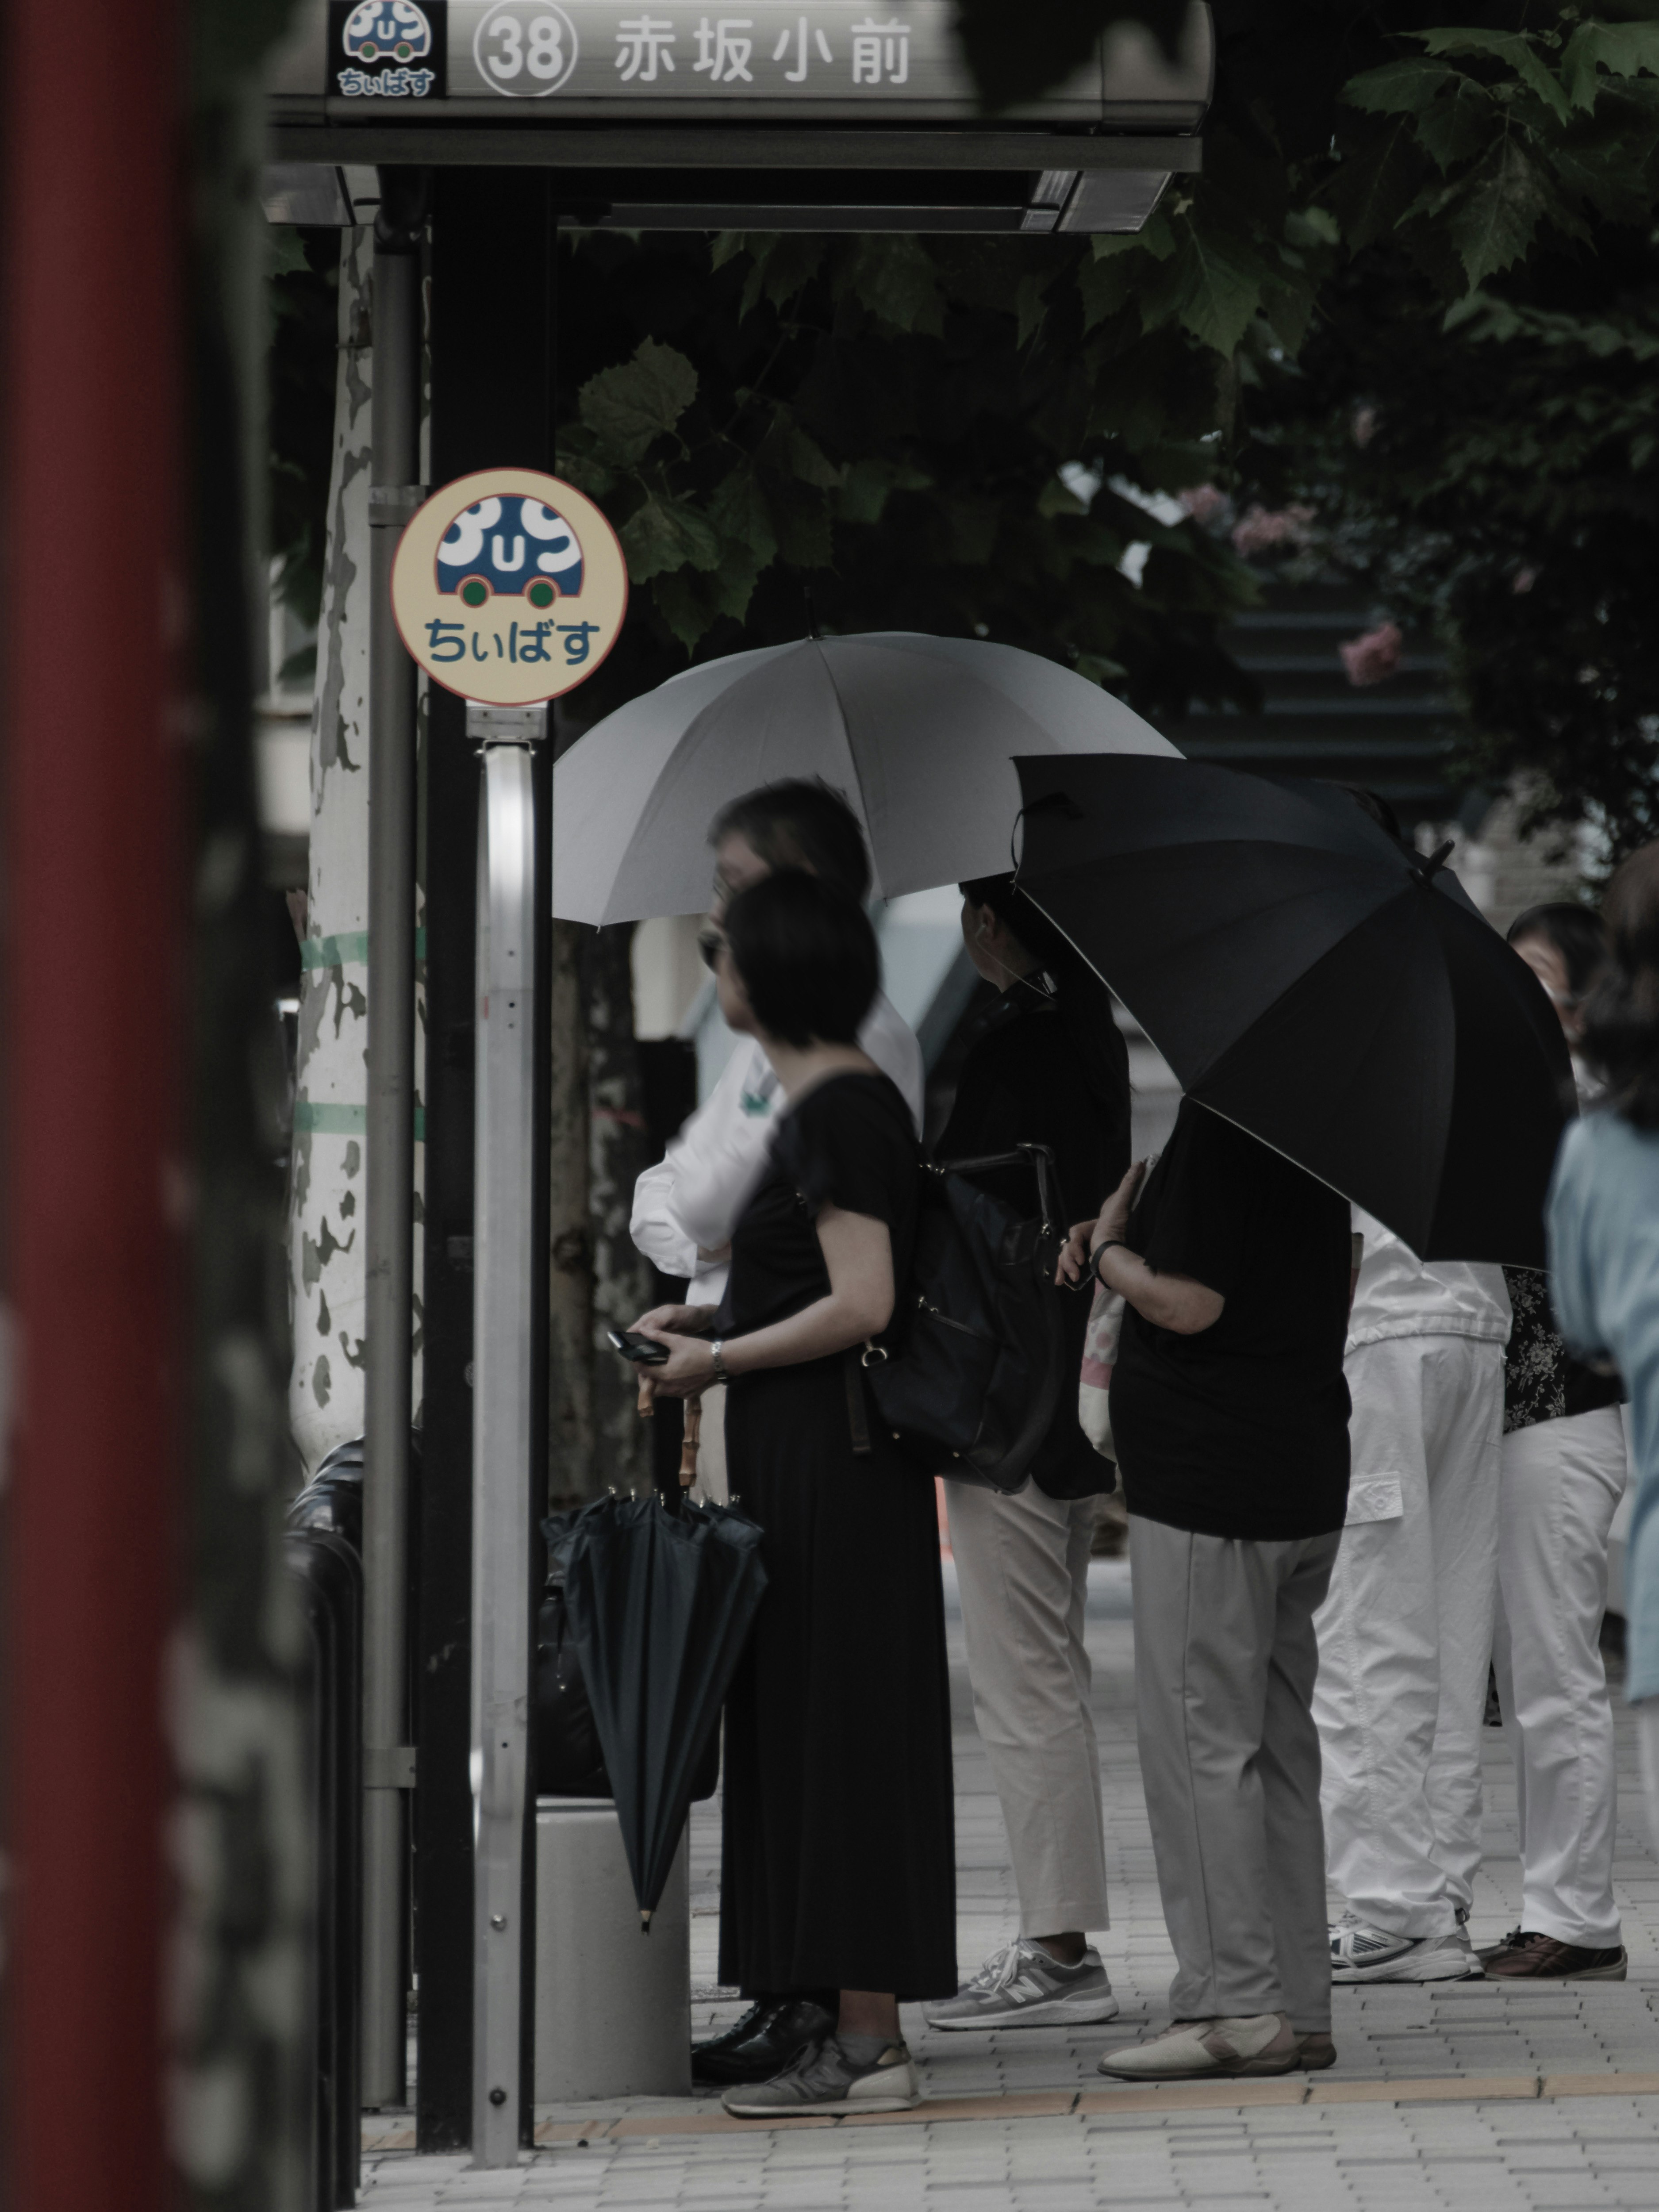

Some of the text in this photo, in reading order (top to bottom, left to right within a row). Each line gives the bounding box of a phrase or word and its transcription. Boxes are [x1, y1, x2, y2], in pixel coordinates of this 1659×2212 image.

[488, 16, 562, 80] 38
[615, 15, 911, 83] 赤坂小前
